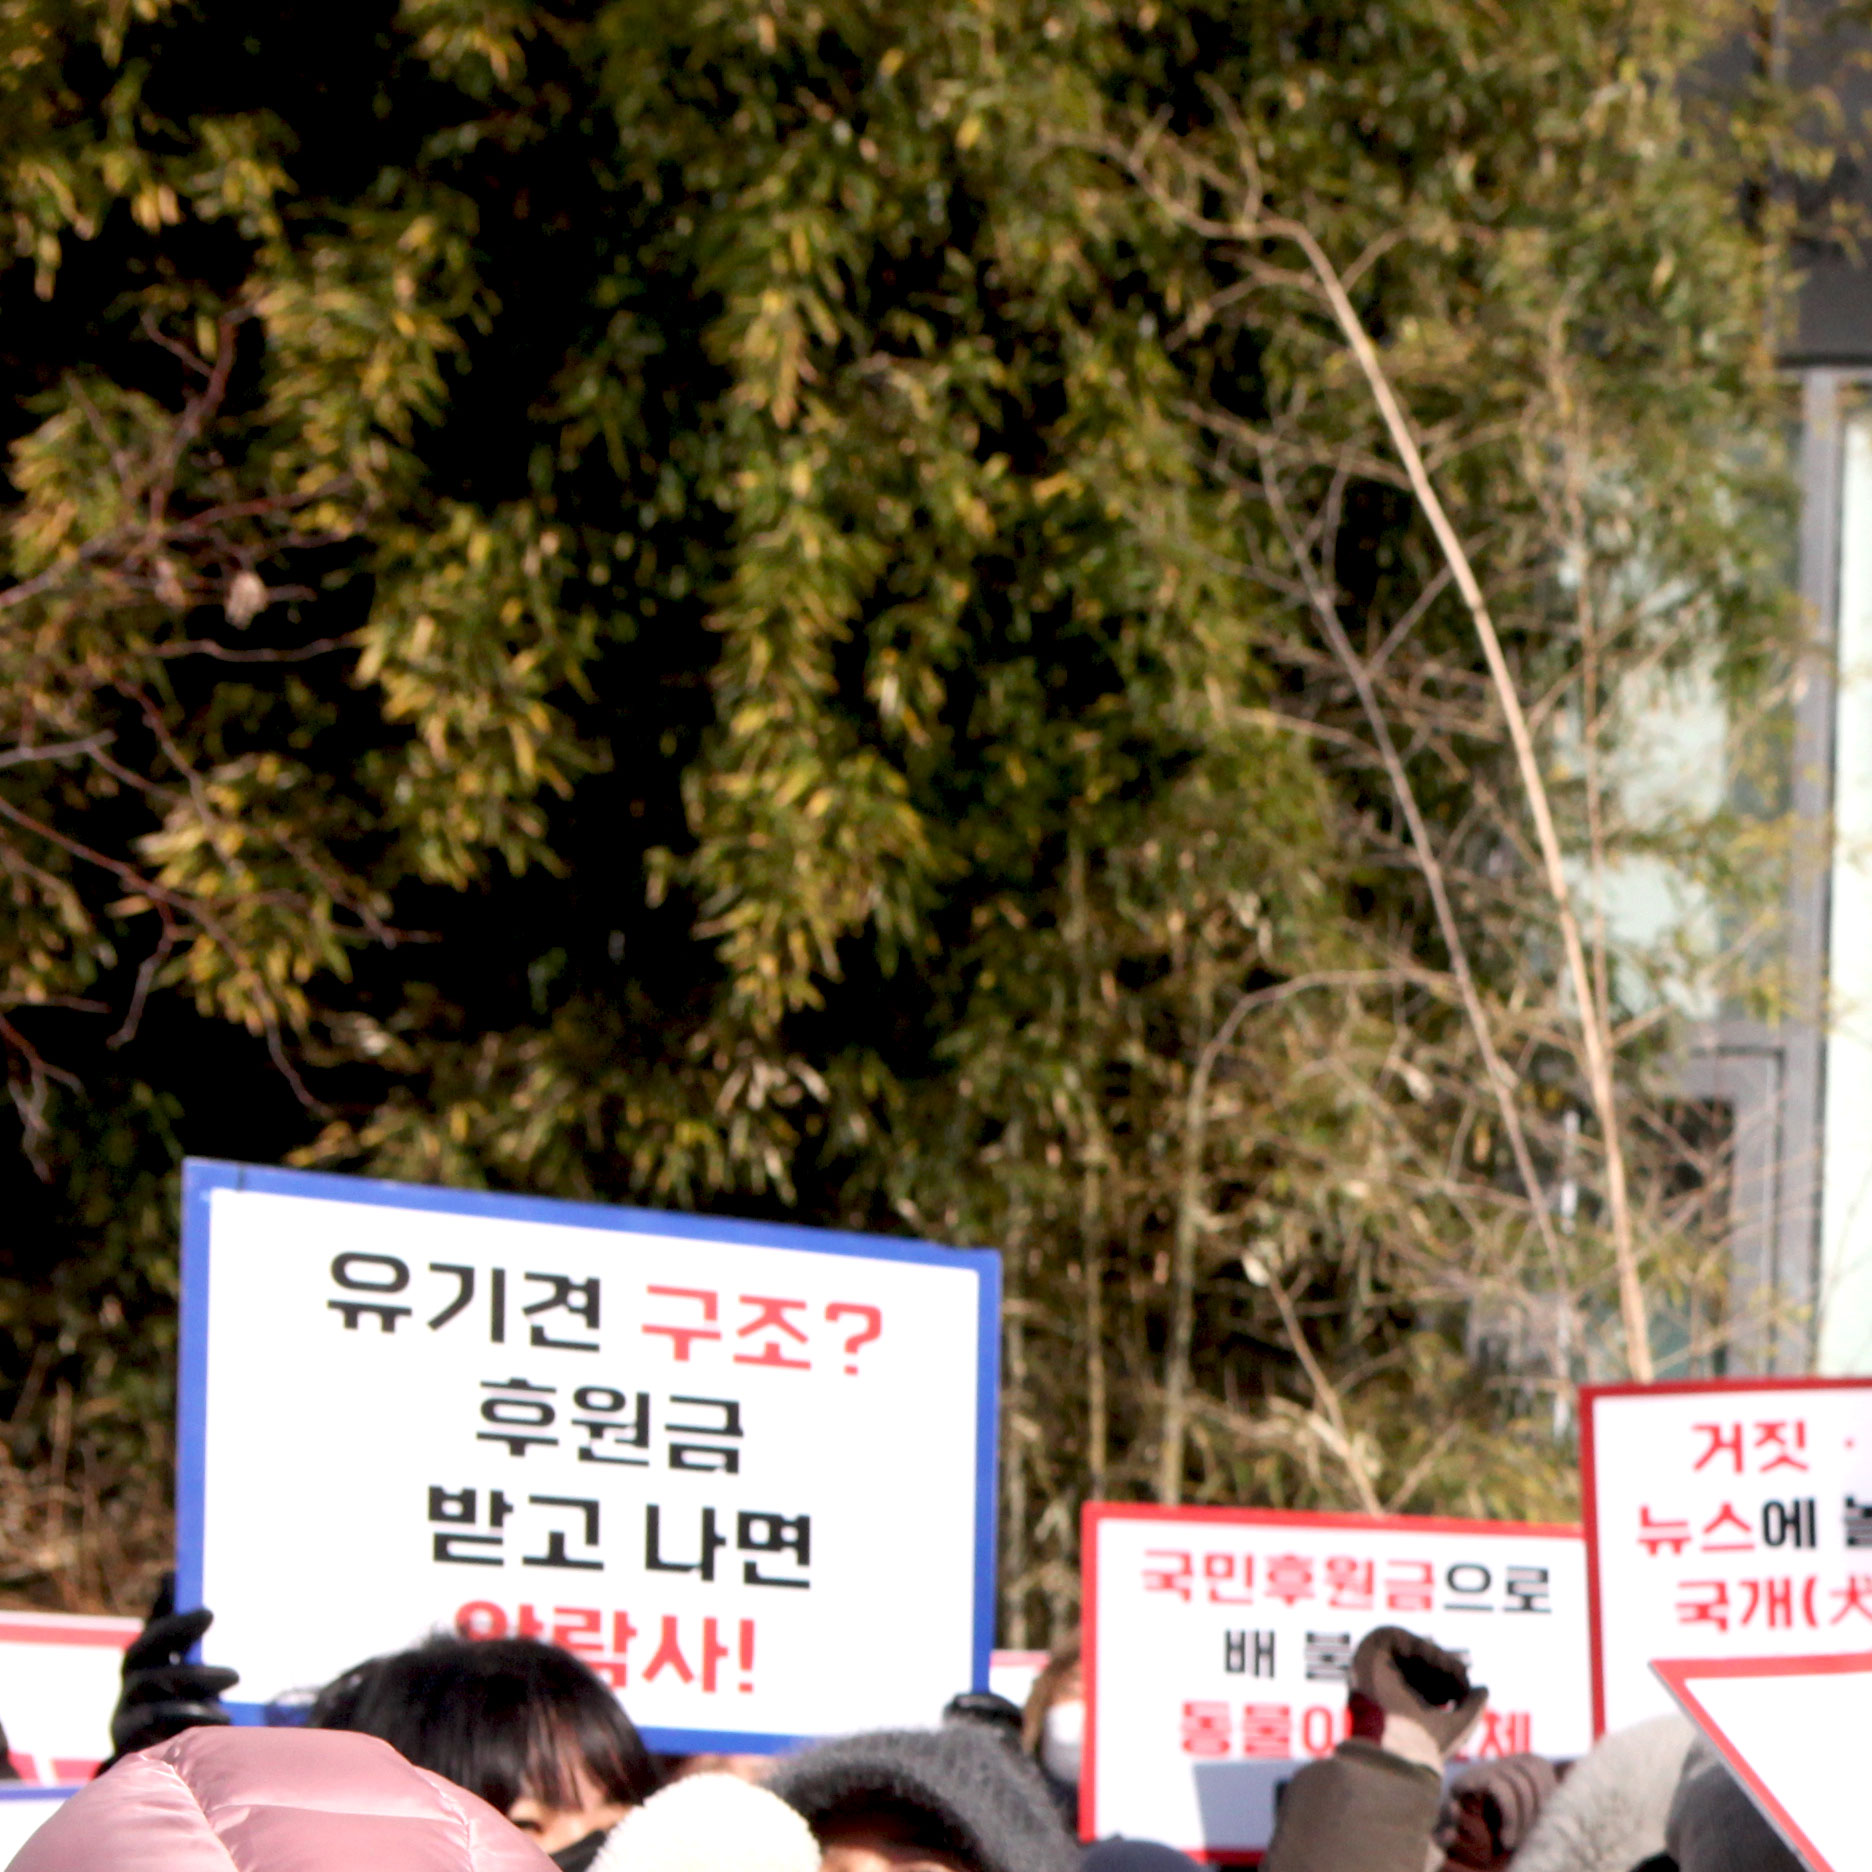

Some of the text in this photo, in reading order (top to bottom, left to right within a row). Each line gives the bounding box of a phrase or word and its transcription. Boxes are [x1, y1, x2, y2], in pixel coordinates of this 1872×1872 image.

[326, 1250, 883, 1375] 유기견 구조?
[476, 1377, 744, 1475] 후원금
[1691, 1419, 1810, 1475] 거짓
[426, 1486, 812, 1590] 받고 나면
[1638, 1496, 1816, 1556] 뉴스에
[1141, 1548, 1552, 1615] 국민후원금으로
[1224, 1629, 1276, 1679] 배
